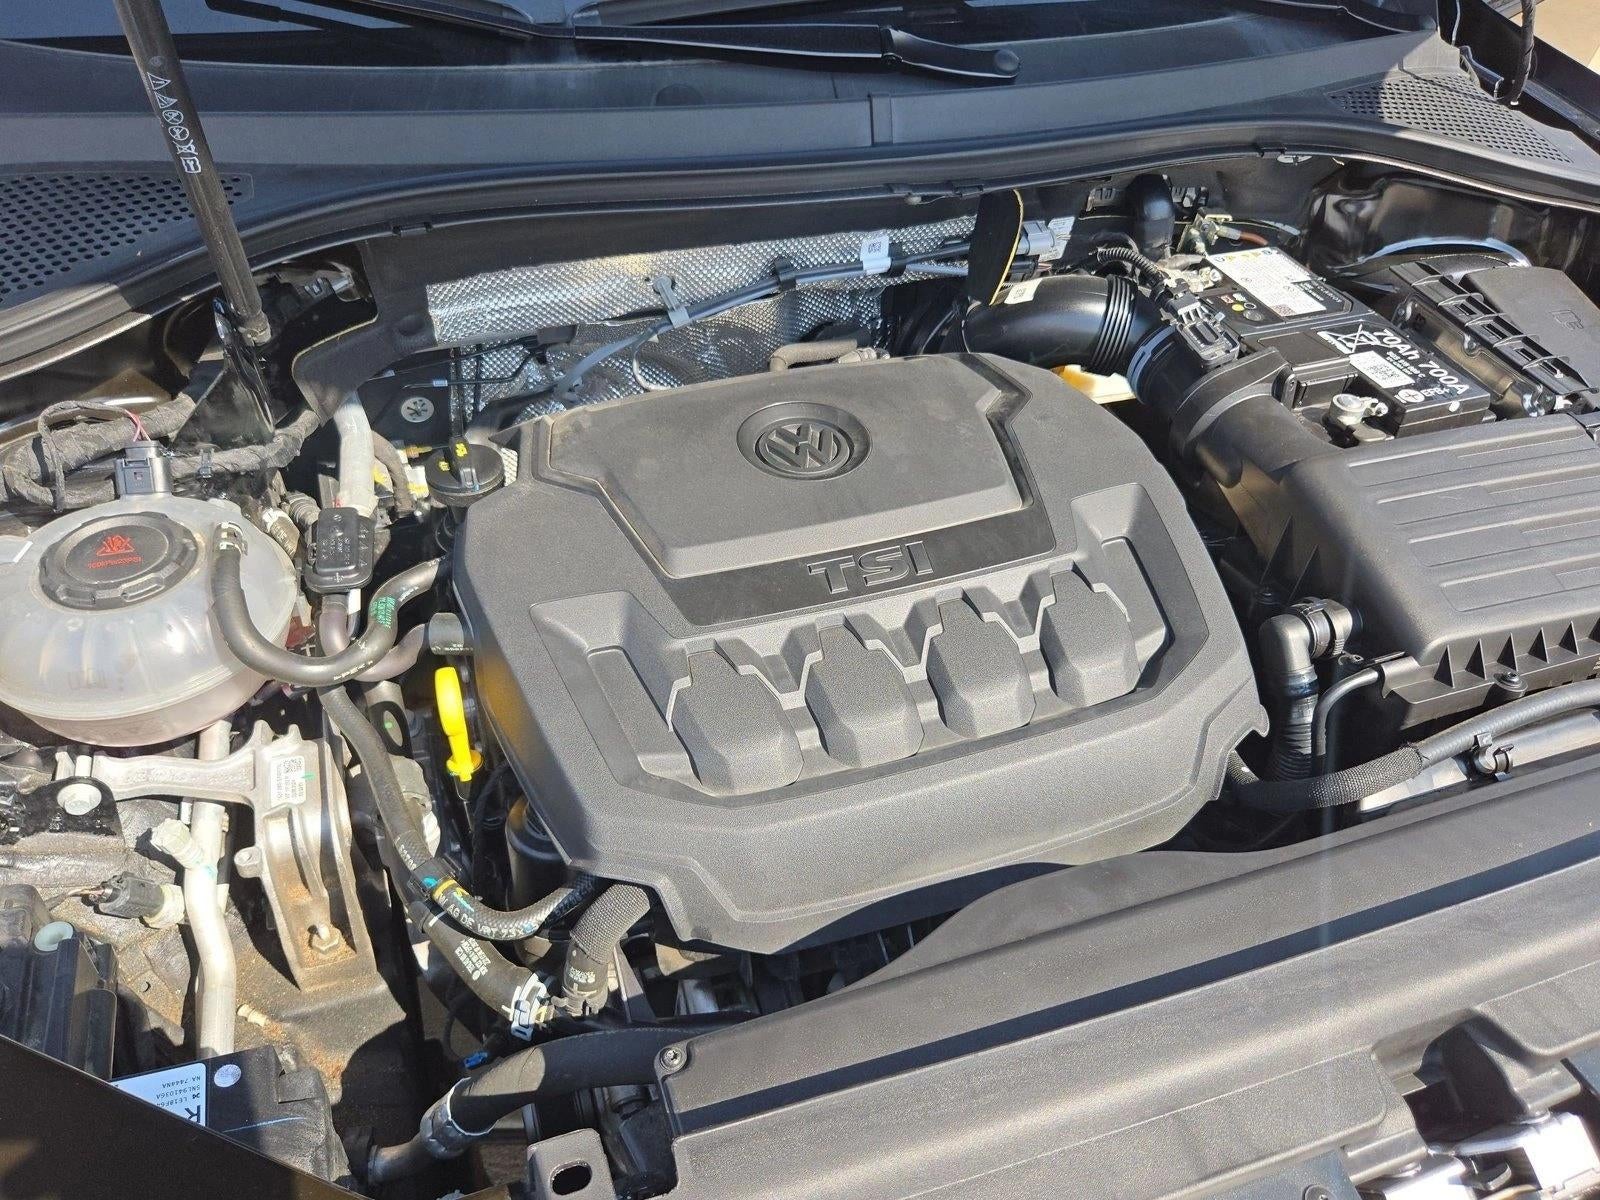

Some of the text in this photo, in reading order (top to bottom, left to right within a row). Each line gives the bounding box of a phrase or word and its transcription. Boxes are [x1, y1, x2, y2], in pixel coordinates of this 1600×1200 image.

[1373, 328, 1420, 360] 70Ah
[1419, 361, 1470, 395] 700A
[807, 541, 934, 594] TSI
